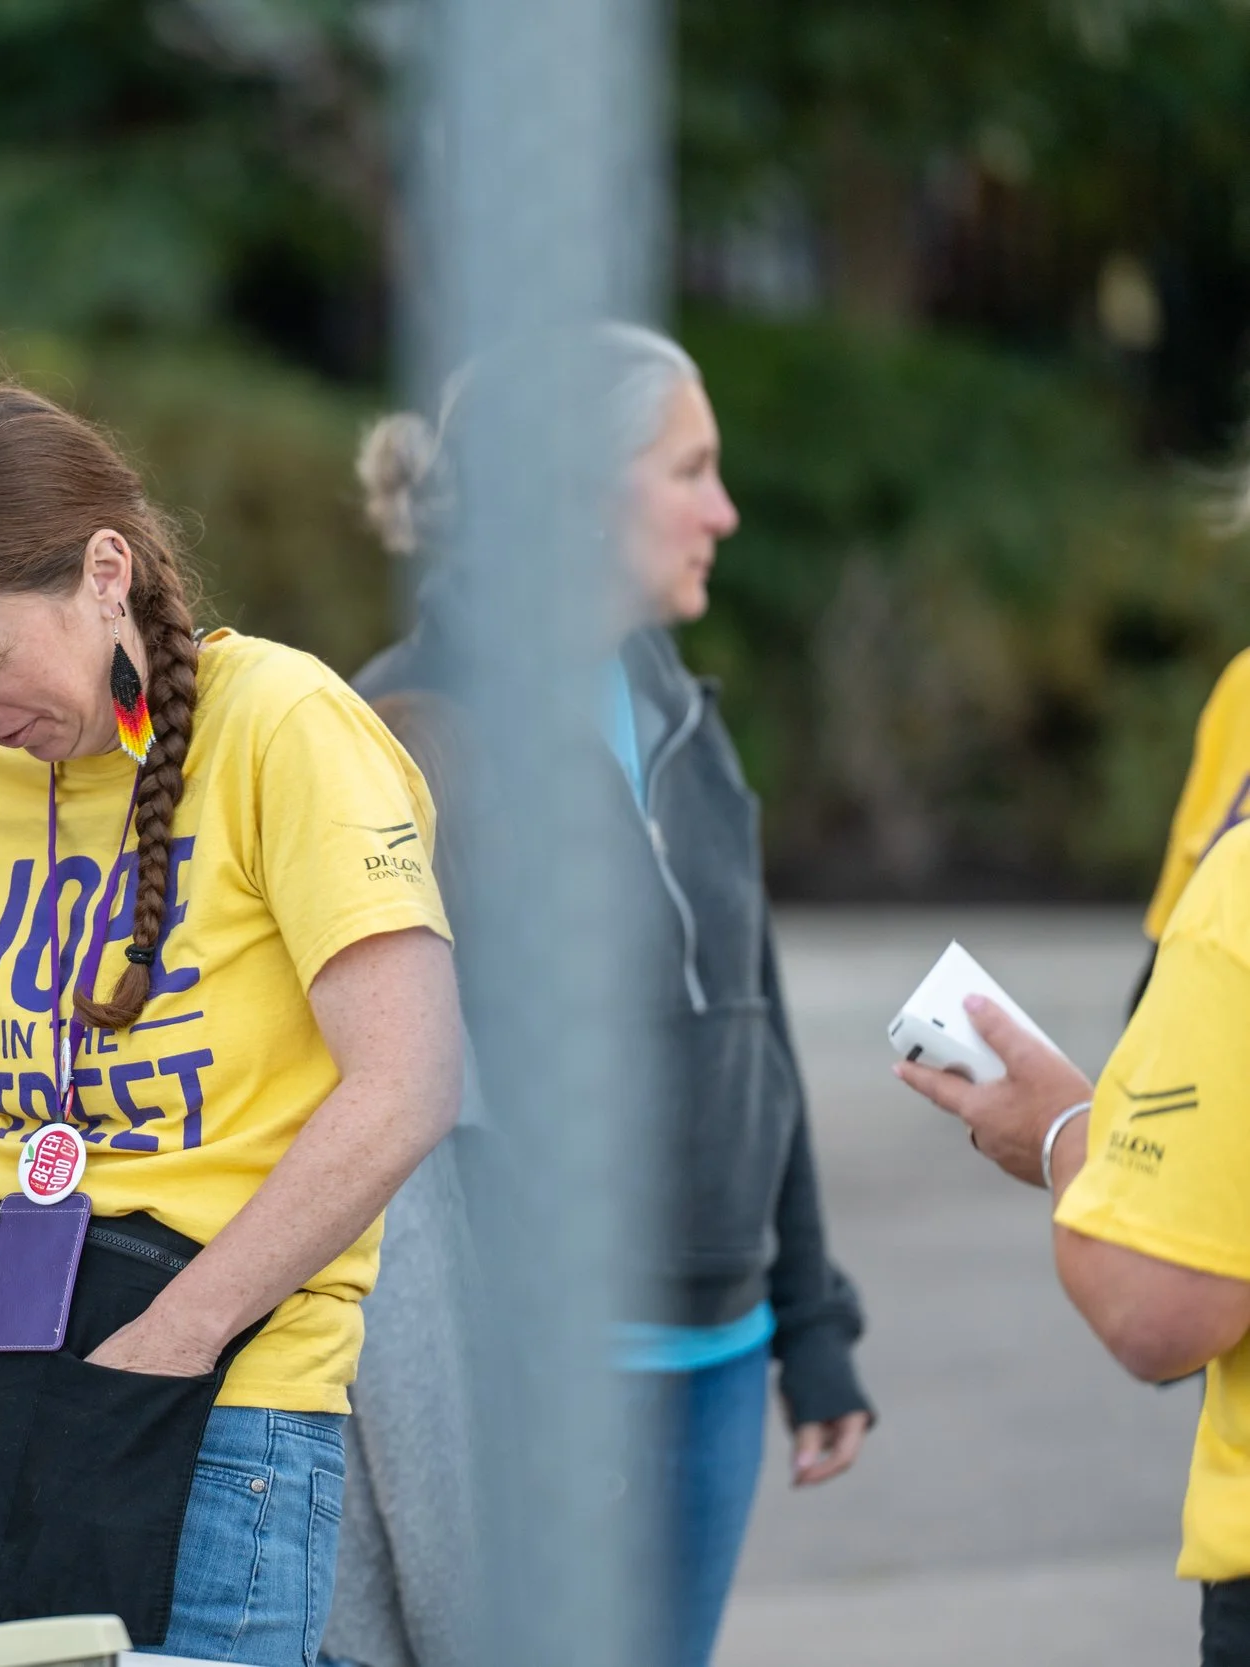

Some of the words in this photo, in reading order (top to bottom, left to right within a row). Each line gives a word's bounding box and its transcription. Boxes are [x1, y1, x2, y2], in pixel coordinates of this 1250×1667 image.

[1, 1019, 37, 1059] IN
[31, 1134, 63, 1183] BETTER
[45, 1158, 72, 1191] FOOD
[59, 1138, 77, 1158] CO
